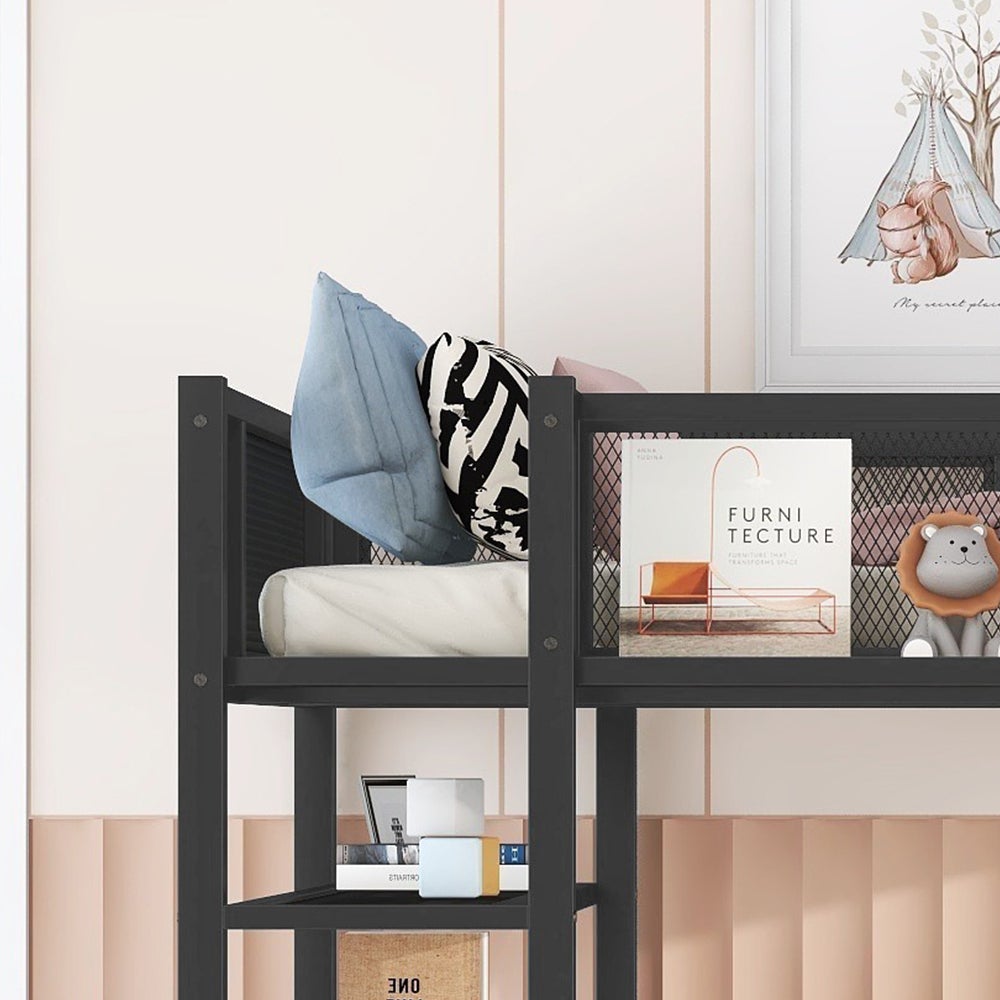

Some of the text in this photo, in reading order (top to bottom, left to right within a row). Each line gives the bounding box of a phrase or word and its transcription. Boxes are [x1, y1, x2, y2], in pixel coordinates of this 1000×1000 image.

[893, 297, 919, 312] My
[925, 299, 966, 307] secret
[728, 507, 801, 522] FURNI
[727, 528, 834, 543] TECTURE
